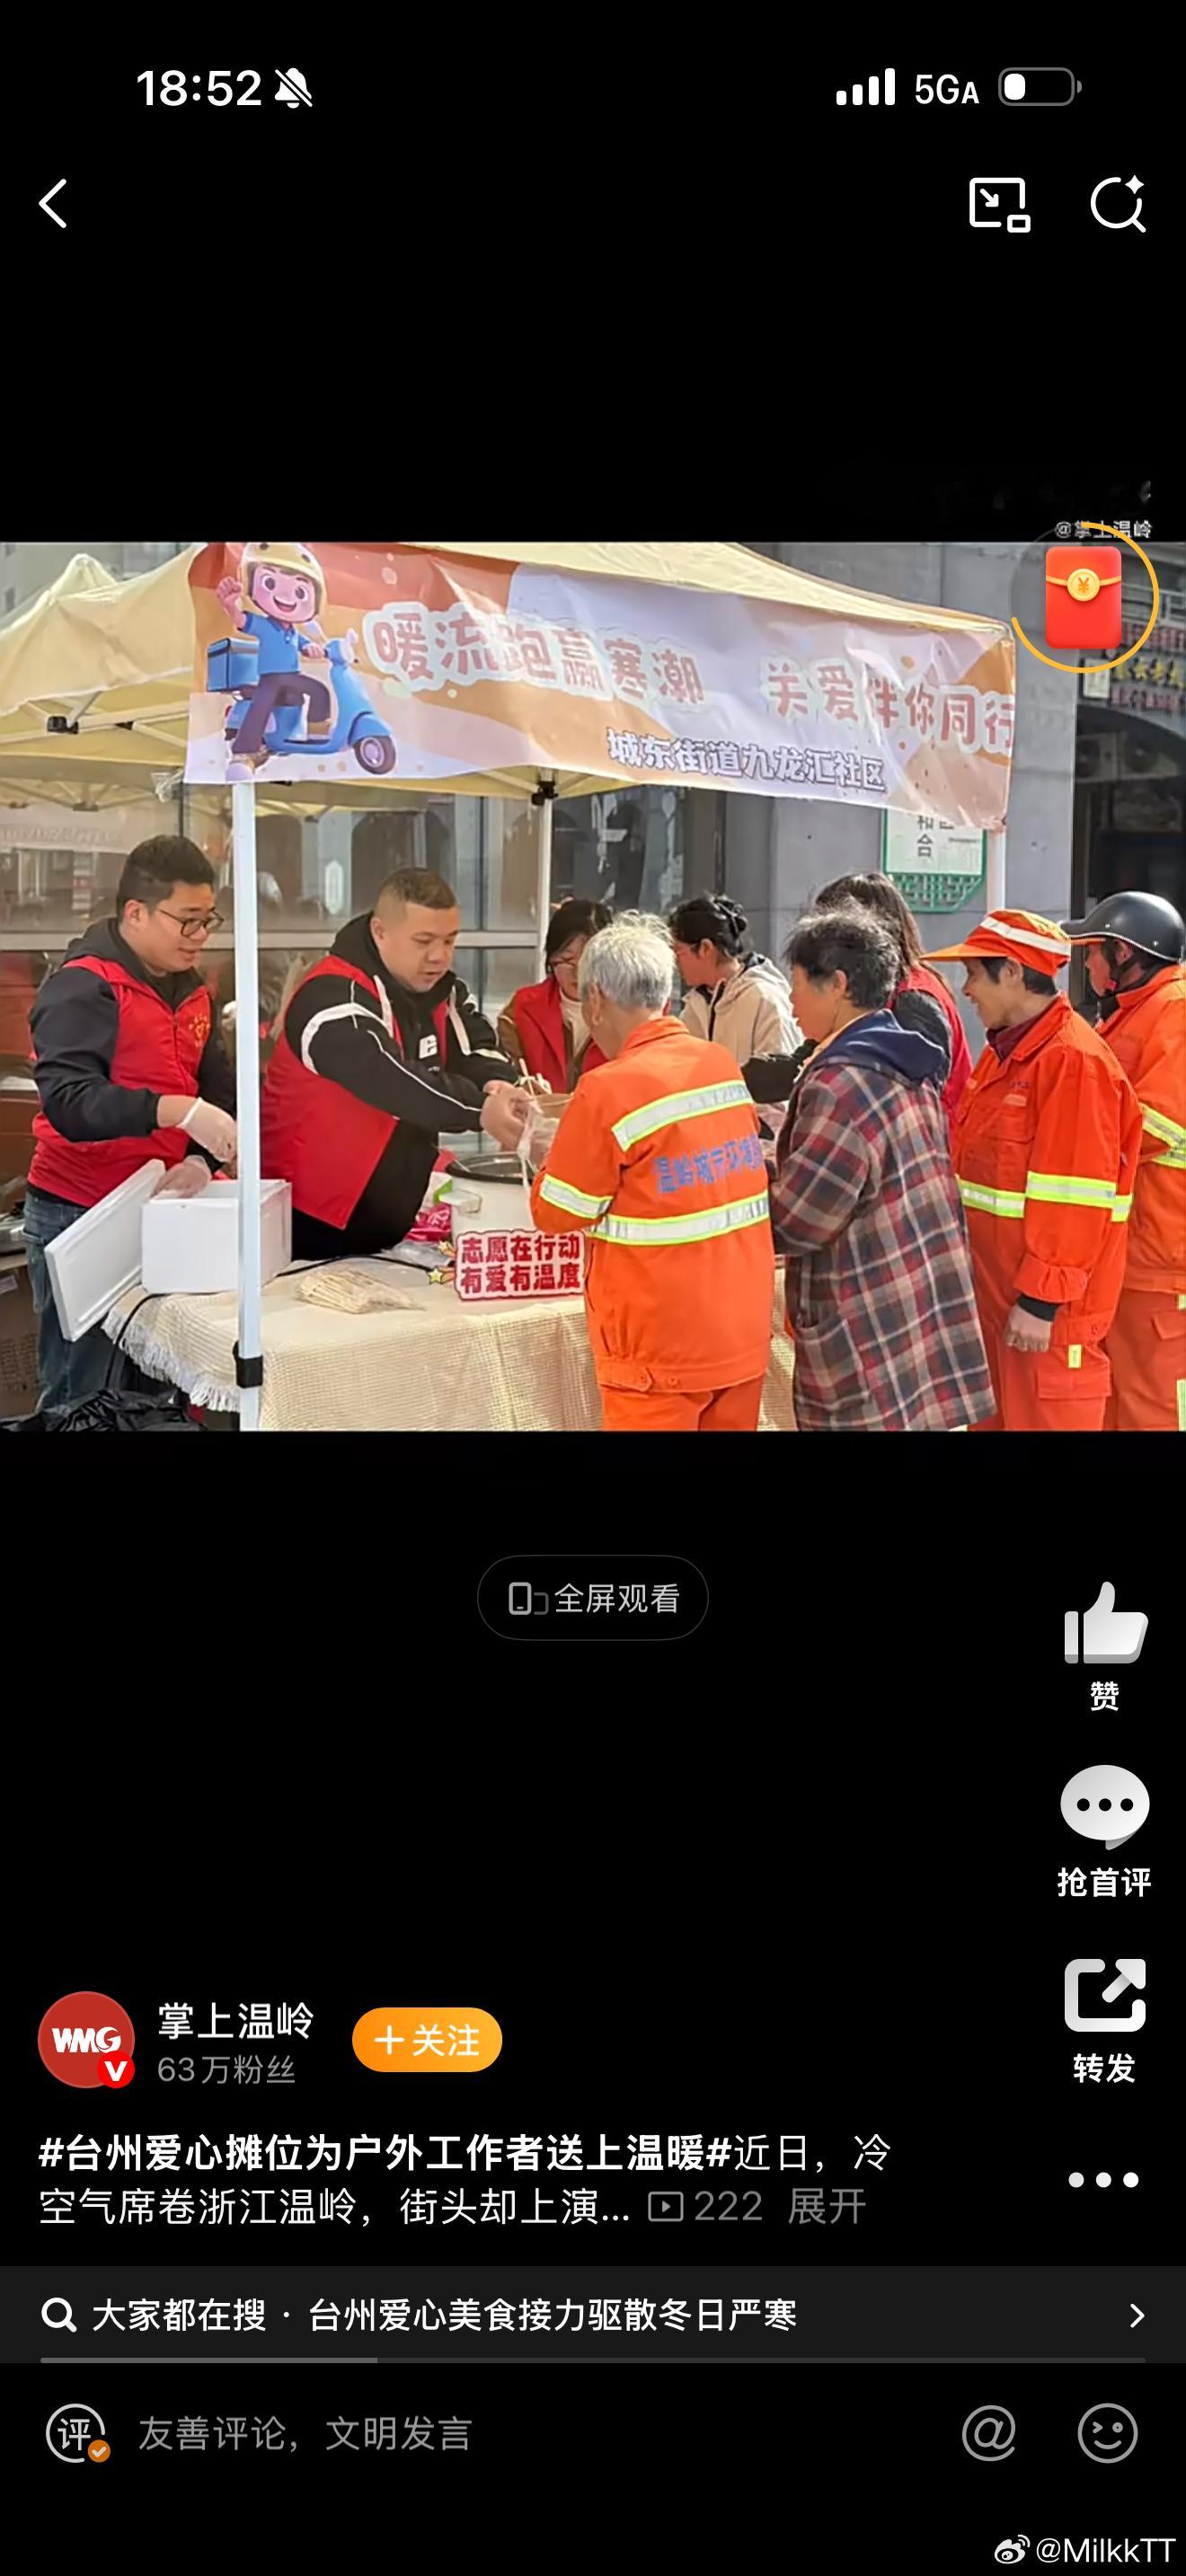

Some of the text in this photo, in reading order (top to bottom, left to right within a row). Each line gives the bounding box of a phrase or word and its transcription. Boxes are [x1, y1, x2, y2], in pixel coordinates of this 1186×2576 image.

[137, 70, 261, 106] 18:52
[916, 74, 979, 104] 5GA
[373, 613, 705, 704] 暖流跑赢寒潮
[767, 662, 1014, 749] 关爱伴你同行
[607, 728, 886, 792] 城东街道九龙汇社区
[462, 1233, 580, 1264] 志愿在行动
[460, 1262, 580, 1294] 有爱有温度
[554, 1584, 679, 1613] 全屏观看
[1091, 1681, 1119, 1711] 赞
[1058, 1867, 1151, 1897] 抢首评
[158, 2002, 314, 2040] 掌上温岭
[51, 2026, 121, 2054] WMG
[1074, 2053, 1135, 2083] 转发
[39, 2134, 891, 2174] #台州爱心摊位为户外工作者送上温暖#近日，冷
[695, 2191, 762, 2220] 222
[789, 2188, 866, 2225] 展开
[57, 2418, 92, 2451] 评
[139, 2416, 473, 2452] 友善评论，文明发言
